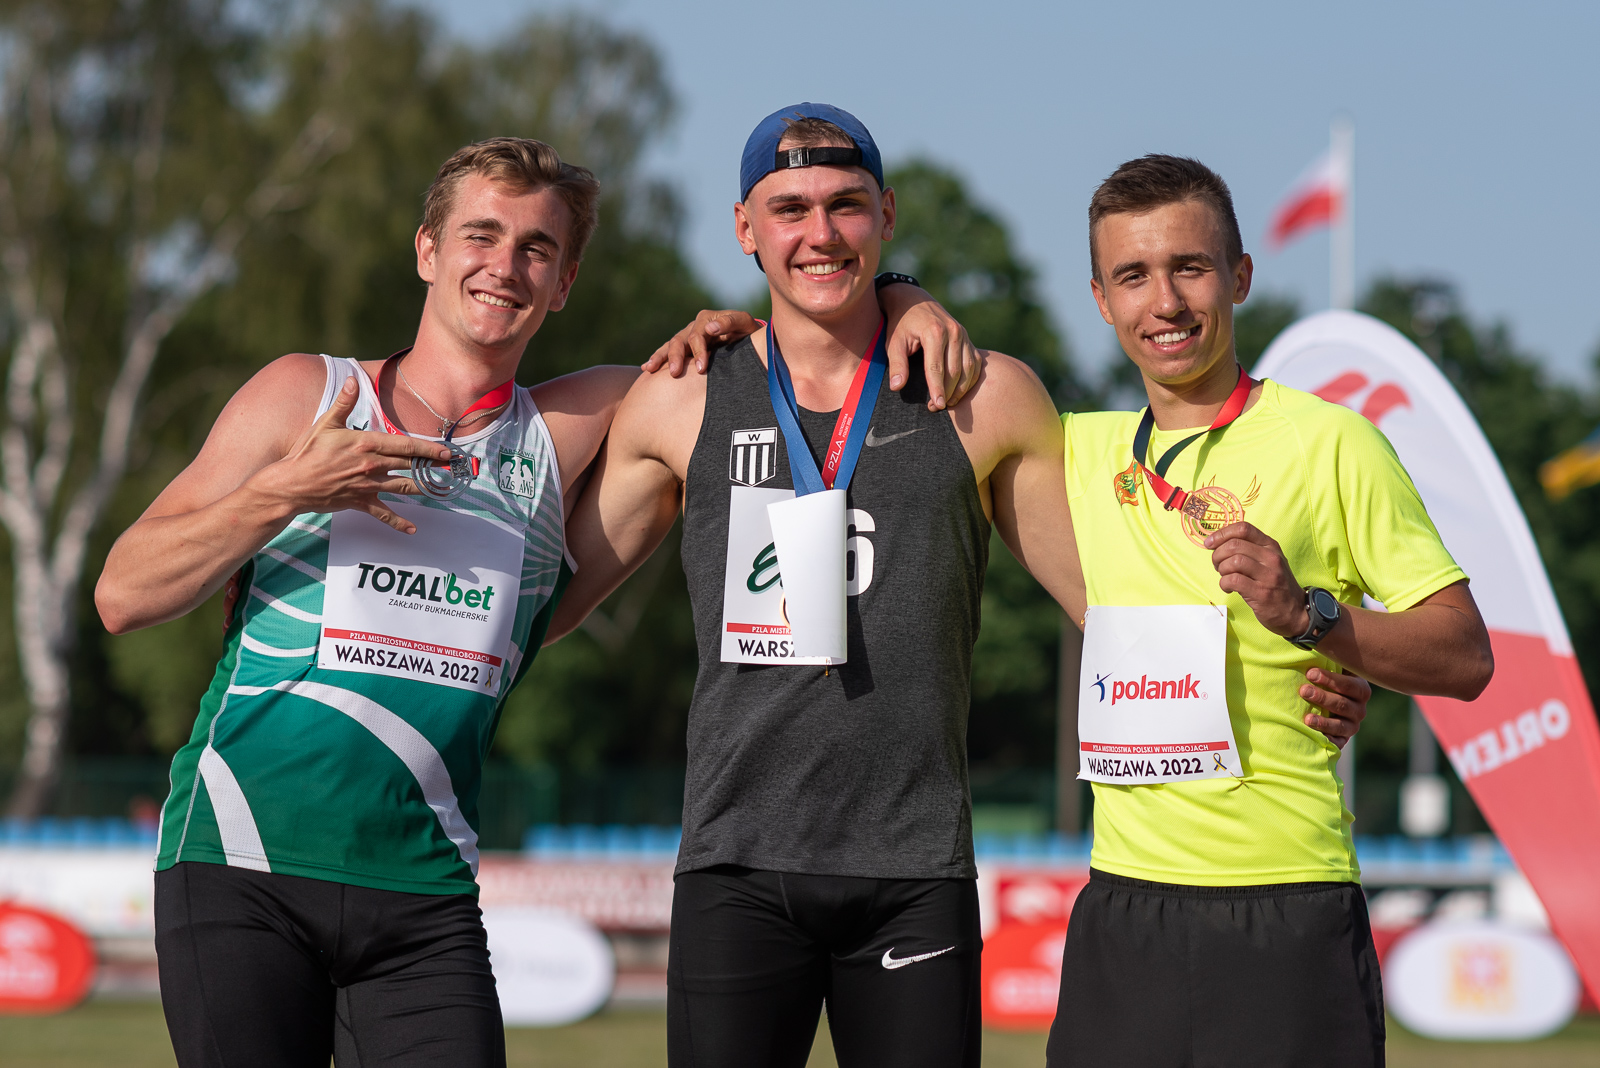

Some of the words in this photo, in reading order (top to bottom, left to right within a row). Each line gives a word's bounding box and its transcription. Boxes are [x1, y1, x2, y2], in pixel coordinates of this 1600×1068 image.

[748, 433, 761, 441] W
[828, 440, 844, 471] PZLA
[501, 476, 515, 490] AZS
[519, 480, 533, 495] AWF
[388, 598, 423, 611] ZAKŁADY
[424, 604, 489, 622] BUKMACHERSKIE
[752, 626, 768, 634] PZLA
[349, 632, 366, 640] PZLA
[367, 635, 413, 649] MISTRZOSTWA
[413, 643, 436, 653] POLSKI
[437, 646, 444, 654] W
[444, 648, 490, 663] WIELOBOJACH
[335, 645, 435, 676] WARSZAWA
[439, 661, 479, 684] 2022
[1112, 673, 1201, 706] polanik
[1102, 745, 1132, 753] MISTRZOSTWA
[1161, 745, 1209, 753] WIELOBOJACH
[1087, 757, 1157, 777] WARSZAWA
[1160, 758, 1204, 776] 2022
